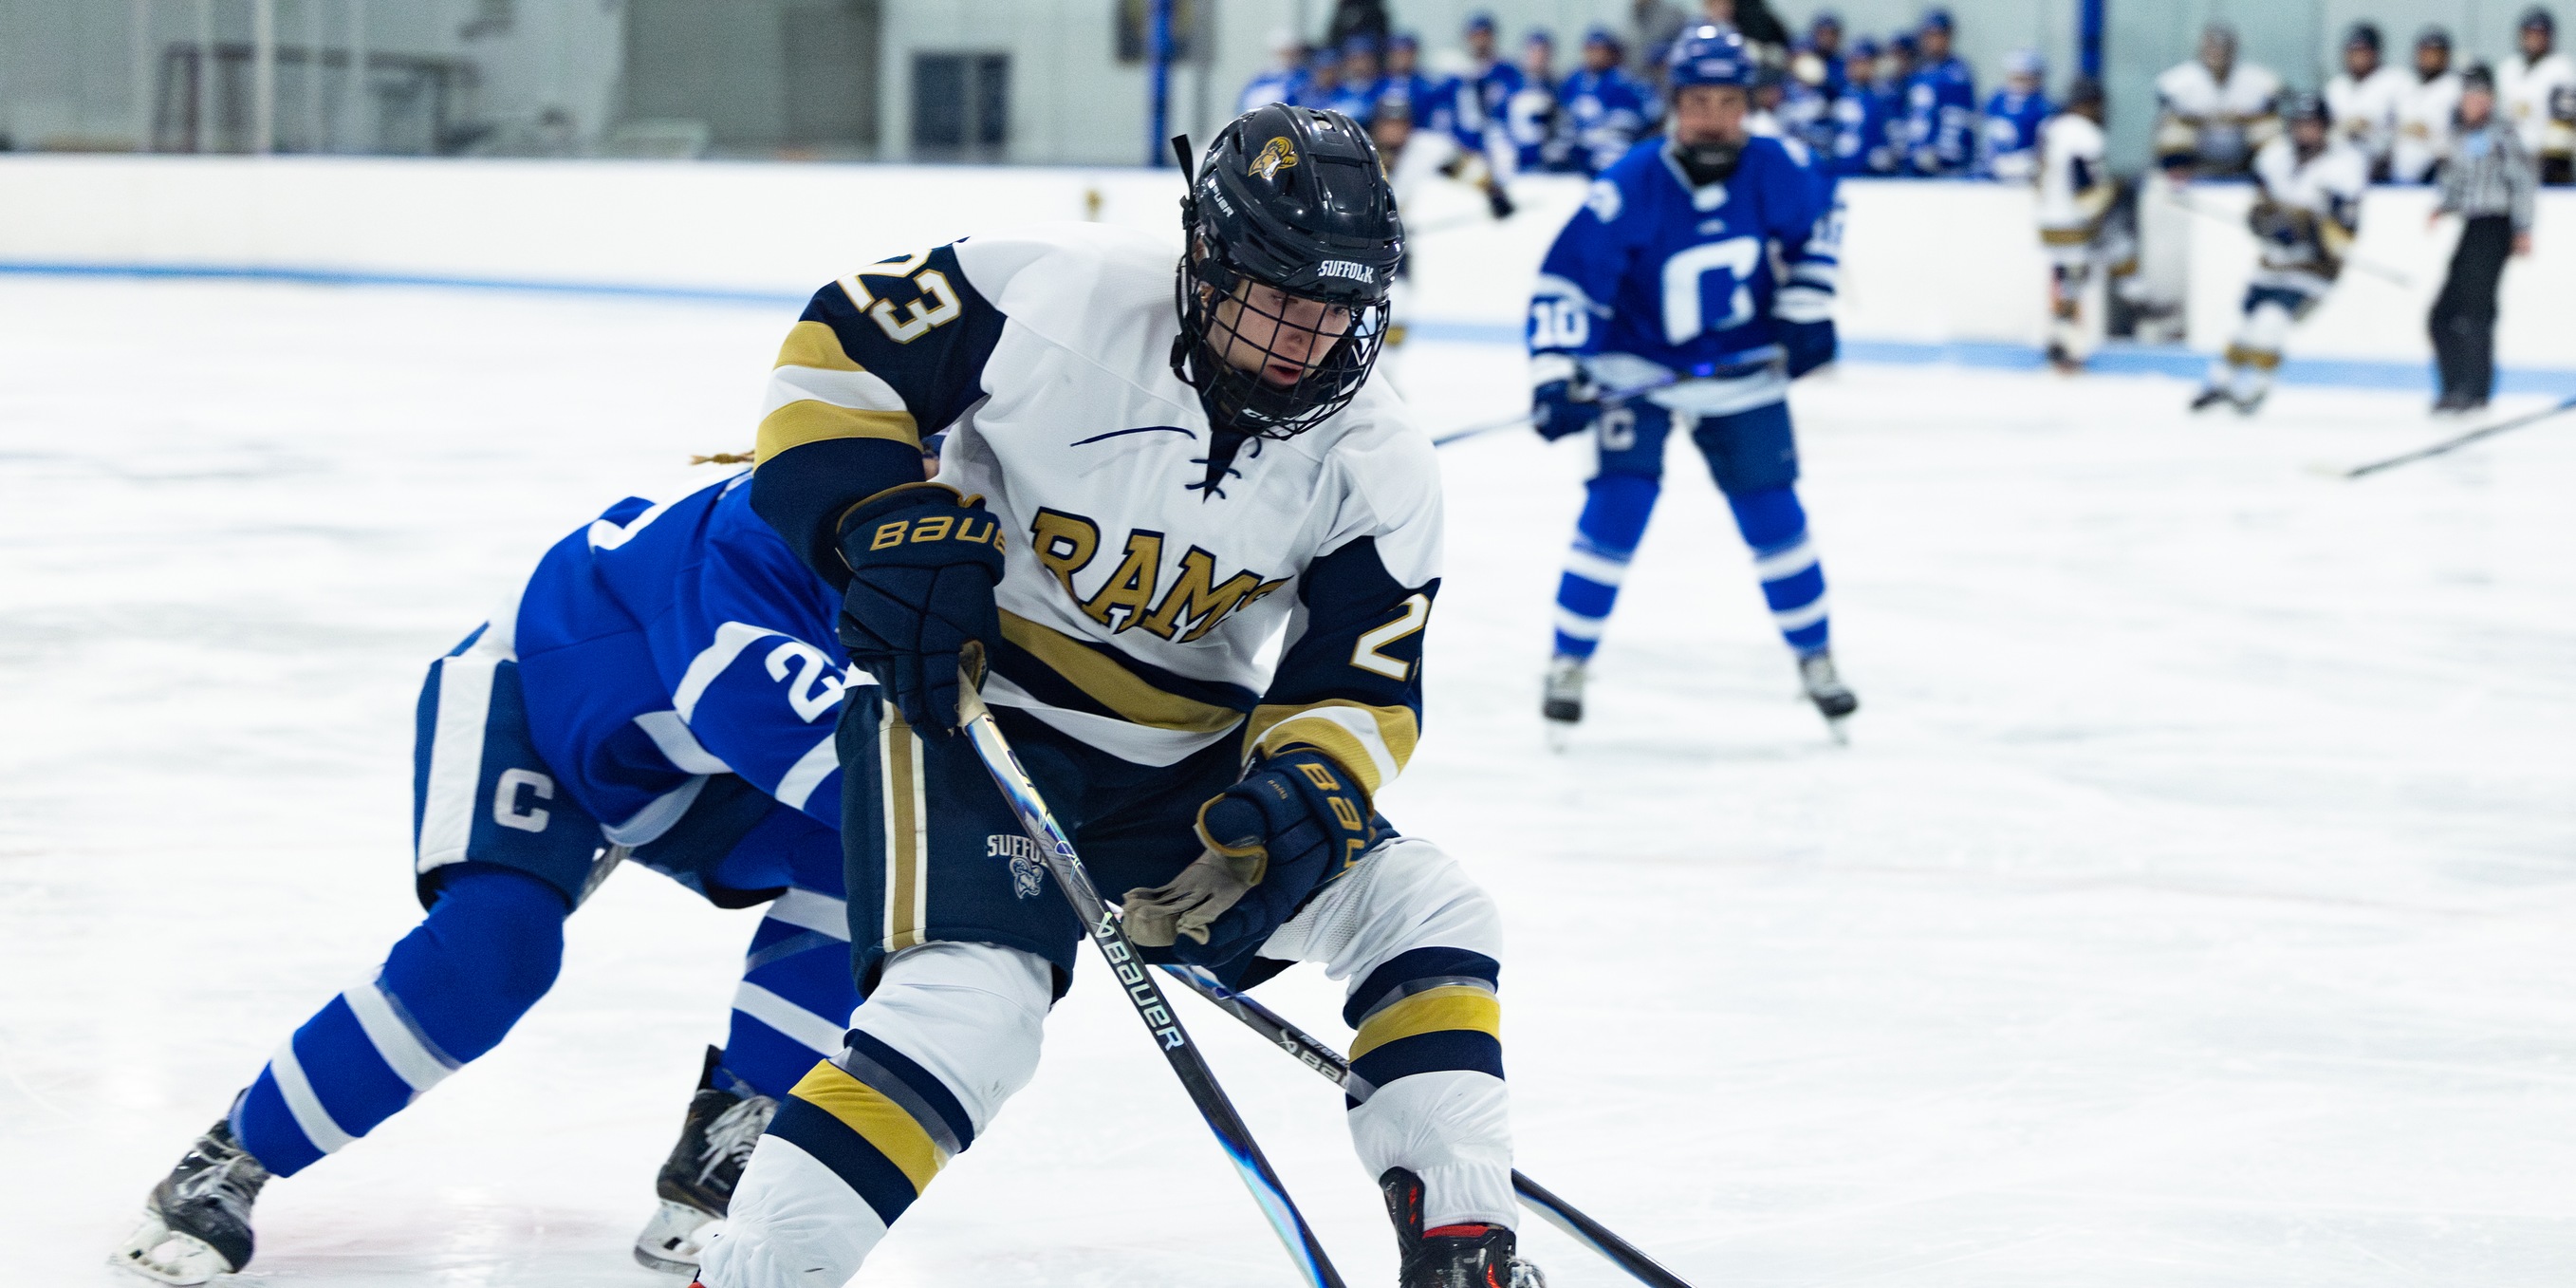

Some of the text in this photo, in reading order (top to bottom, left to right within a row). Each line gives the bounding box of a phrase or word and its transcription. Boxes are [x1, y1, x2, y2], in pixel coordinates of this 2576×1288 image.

[837, 249, 962, 344] 23
[1317, 259, 1375, 285] SUFFOLK
[1662, 236, 1761, 345] C
[1531, 300, 1590, 349] 10
[1600, 408, 1637, 451] C
[869, 516, 1006, 556] BAU
[1348, 593, 1431, 683] 2
[493, 768, 554, 832] C
[1295, 762, 1365, 868] BAU
[987, 834, 1048, 868] SUFFO
[1103, 941, 1185, 1052] BAUER
